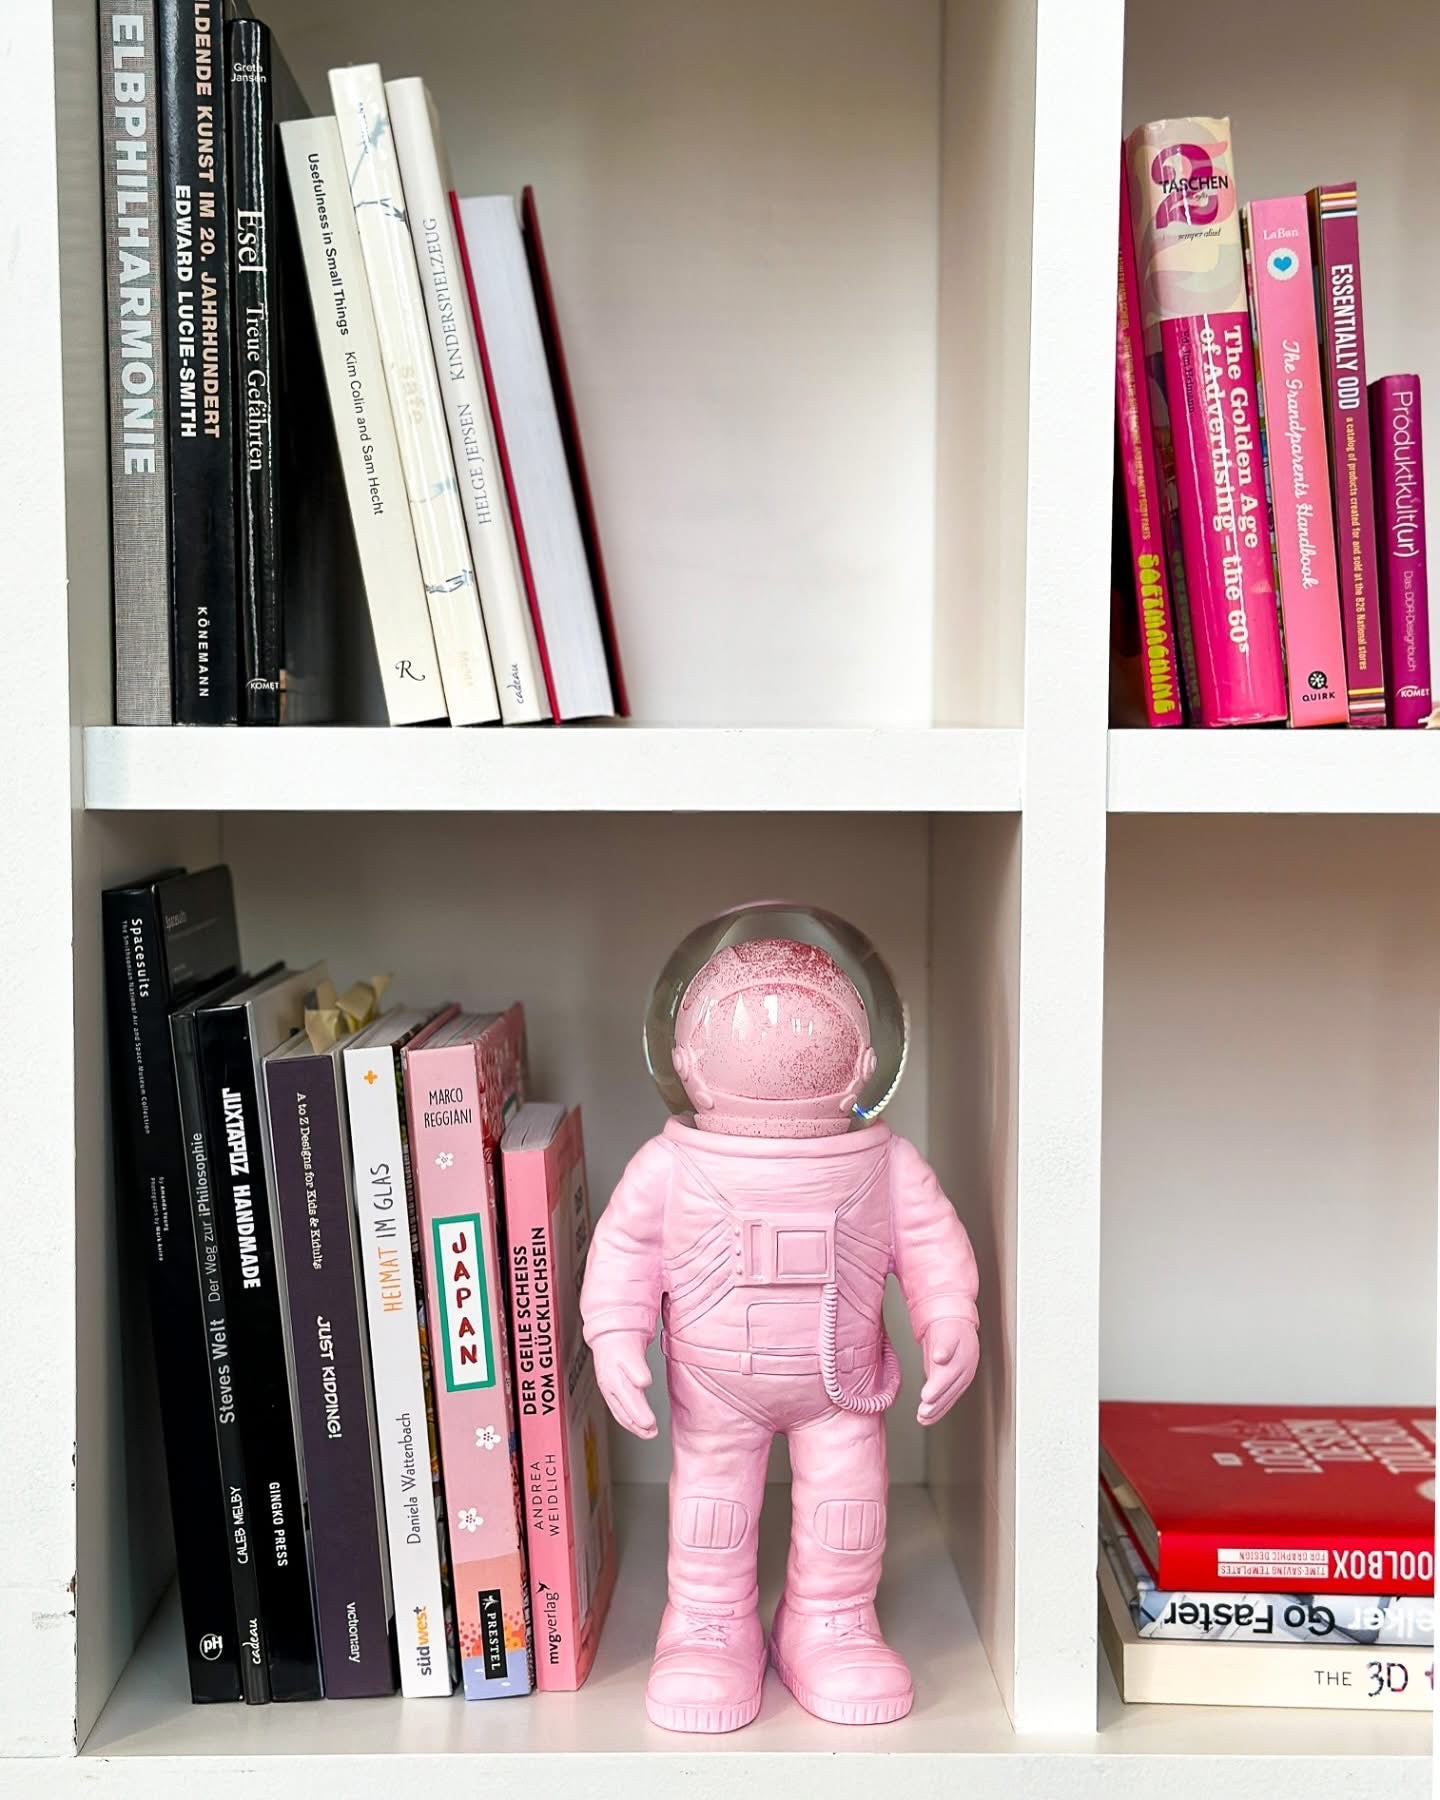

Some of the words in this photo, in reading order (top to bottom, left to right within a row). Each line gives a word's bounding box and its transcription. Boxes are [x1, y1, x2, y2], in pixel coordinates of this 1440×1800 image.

[195, 0, 211, 95] LDENDE
[231, 72, 267, 83] Jansen
[197, 106, 214, 182] KUNST
[308, 154, 328, 229] Usefulness
[1159, 176, 1229, 194] TASCHEN
[199, 192, 214, 217] IM
[112, 14, 156, 475] ELBPHILHARMONIE
[173, 184, 192, 281] EDWARD
[200, 227, 215, 261] 20.
[236, 207, 266, 272] Esel
[322, 232, 333, 244] in
[326, 248, 342, 286] Small
[334, 289, 348, 335] Things
[423, 219, 464, 381] KINDERSPIELZEUG
[1332, 264, 1358, 370] ESSENTIALLY
[245, 303, 265, 361] Treue
[1199, 326, 1221, 357] of
[178, 292, 196, 437] LUCIE-SMITH
[201, 272, 219, 438] JAHRHUNDERT
[345, 352, 357, 377] Kim
[1224, 325, 1243, 380] The
[1283, 340, 1300, 373] The
[351, 381, 363, 413] Colin
[1338, 377, 1359, 409] ODD
[247, 369, 268, 471] Gefährten
[357, 418, 371, 441] and
[457, 404, 484, 462] JEPSEN
[1230, 387, 1253, 487] Golden
[1285, 379, 1309, 499] Grandparents
[1346, 424, 1355, 452] catalog
[362, 446, 374, 474] Sam
[1201, 361, 1239, 532] Advertising
[1348, 453, 1357, 461] of
[368, 477, 383, 515] Hecht
[470, 468, 491, 524] HELGE
[1347, 463, 1357, 496] products
[1233, 493, 1258, 548] Age
[1350, 497, 1360, 526] created
[1296, 503, 1318, 589] Handbook
[1352, 528, 1360, 538] for
[1353, 541, 1361, 554] and
[1221, 554, 1246, 601] the
[1353, 556, 1363, 571] sold
[1354, 573, 1363, 581] at
[1404, 571, 1413, 589] Das
[1355, 583, 1363, 595] the
[1357, 614, 1367, 645] National
[1404, 591, 1416, 671] DDR-Designbuch
[198, 606, 210, 697] KÖNEMANN
[395, 660, 425, 681] R
[1358, 646, 1366, 670] stores
[248, 680, 279, 691] KOMET
[506, 664, 524, 704] cadeau
[1302, 691, 1336, 702] QUIRK
[1398, 687, 1430, 698] KOMET
[130, 919, 149, 997] Spacesuits
[123, 935, 132, 980] Smithsonian
[141, 1097, 150, 1134] Collection
[297, 1093, 306, 1102] A
[298, 1104, 307, 1115] to
[429, 1088, 463, 1106] MARCO
[222, 1088, 249, 1175] JUXTAPOZ
[300, 1117, 309, 1125] Z
[424, 1108, 472, 1128] REGGIANI
[300, 1127, 311, 1170] Designs
[191, 1133, 210, 1216] iPhilosophie
[305, 1172, 314, 1188] for
[370, 1164, 393, 1210] GLAS
[307, 1190, 317, 1215] Kids
[203, 1221, 213, 1242] zur
[233, 1185, 261, 1288] HANDMADE
[310, 1217, 319, 1227] &
[374, 1219, 396, 1238] IM
[205, 1246, 217, 1275] Weg
[311, 1229, 322, 1269] Kidults
[208, 1279, 220, 1302] Der
[378, 1248, 402, 1312] HEIMAT
[452, 1231, 478, 1366] JAPAN
[513, 1246, 531, 1318] SCHEISS
[532, 1228, 553, 1368] GLÜCKLICHSEIN
[210, 1319, 228, 1360] Welt
[317, 1316, 334, 1360] JUST
[518, 1324, 534, 1372] GEILE
[218, 1365, 235, 1423] Steves
[322, 1366, 342, 1438] KIDDING!
[522, 1380, 536, 1415] DER
[541, 1373, 555, 1415] VOM
[396, 1413, 416, 1492] Wattenbach
[230, 1487, 244, 1524] MELBY
[269, 1482, 283, 1524] GINGKO
[530, 1462, 543, 1530] ANDREA
[545, 1455, 559, 1536] WEIDLICH
[404, 1497, 421, 1544] Daniela
[235, 1528, 248, 1564] CALEB
[274, 1529, 288, 1566] PRESS
[1239, 1551, 1270, 1561] DESIGN
[1272, 1551, 1308, 1561] GRAPHIC
[1309, 1552, 1326, 1561] FOR
[1220, 1564, 1270, 1576] TEMPLATES
[544, 1592, 562, 1664] mvgverlag
[1164, 1602, 1274, 1634] Faster
[1284, 1604, 1336, 1636] Go
[242, 1618, 261, 1664] cadeau
[414, 1605, 432, 1676] südwest
[487, 1612, 501, 1671] PRESTEL
[1314, 1670, 1352, 1686] THE
[1366, 1661, 1409, 1697] 3D
